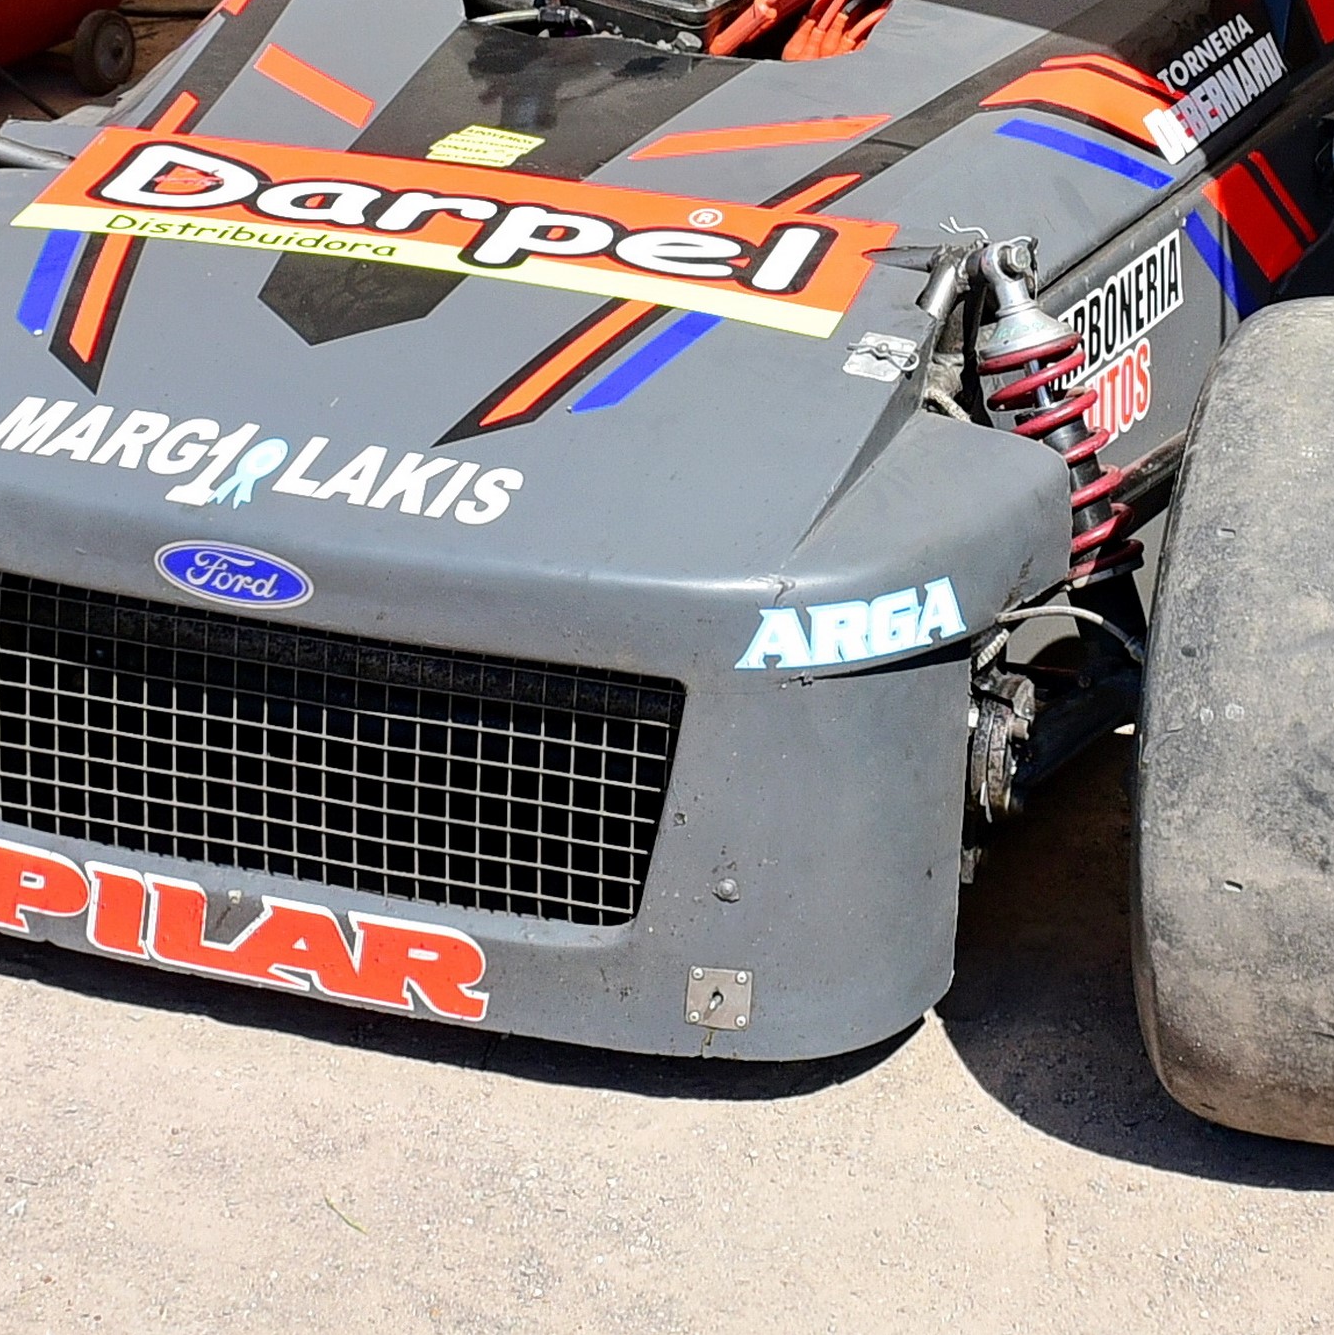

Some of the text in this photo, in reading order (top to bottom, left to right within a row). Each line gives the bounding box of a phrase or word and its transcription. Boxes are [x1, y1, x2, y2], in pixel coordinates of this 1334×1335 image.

[1156, 13, 1254, 94] TORNERIA
[94, 142, 829, 293] Darpel
[105, 213, 398, 258] Distribuidora
[1047, 236, 1181, 391] RBONERIA
[734, 576, 966, 670] ARGA
